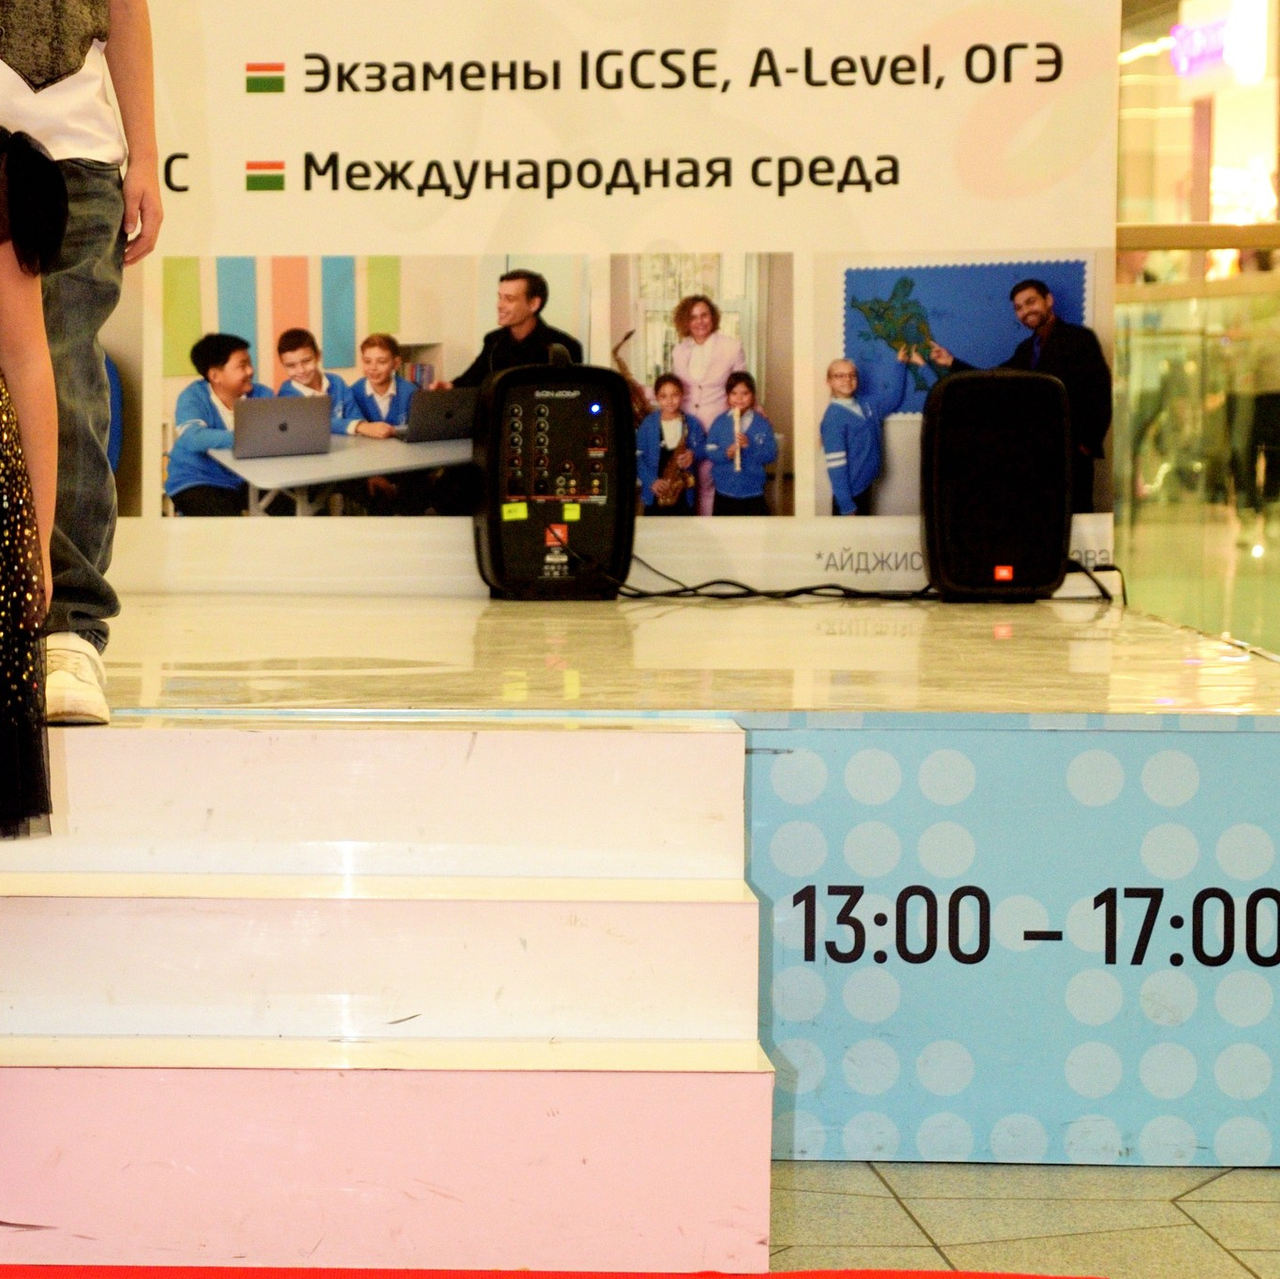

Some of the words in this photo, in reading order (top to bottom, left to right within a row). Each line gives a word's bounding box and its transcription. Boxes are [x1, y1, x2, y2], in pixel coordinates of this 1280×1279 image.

[303, 53, 562, 93] Экзамены
[580, 48, 730, 93] IGCSE,
[749, 44, 945, 91] A-Level,
[964, 42, 1064, 85] ОГЭ
[303, 152, 732, 199] Международная
[751, 154, 900, 197] среда
[792, 885, 991, 964] 13:00
[1092, 887, 1280, 968] 17:00
